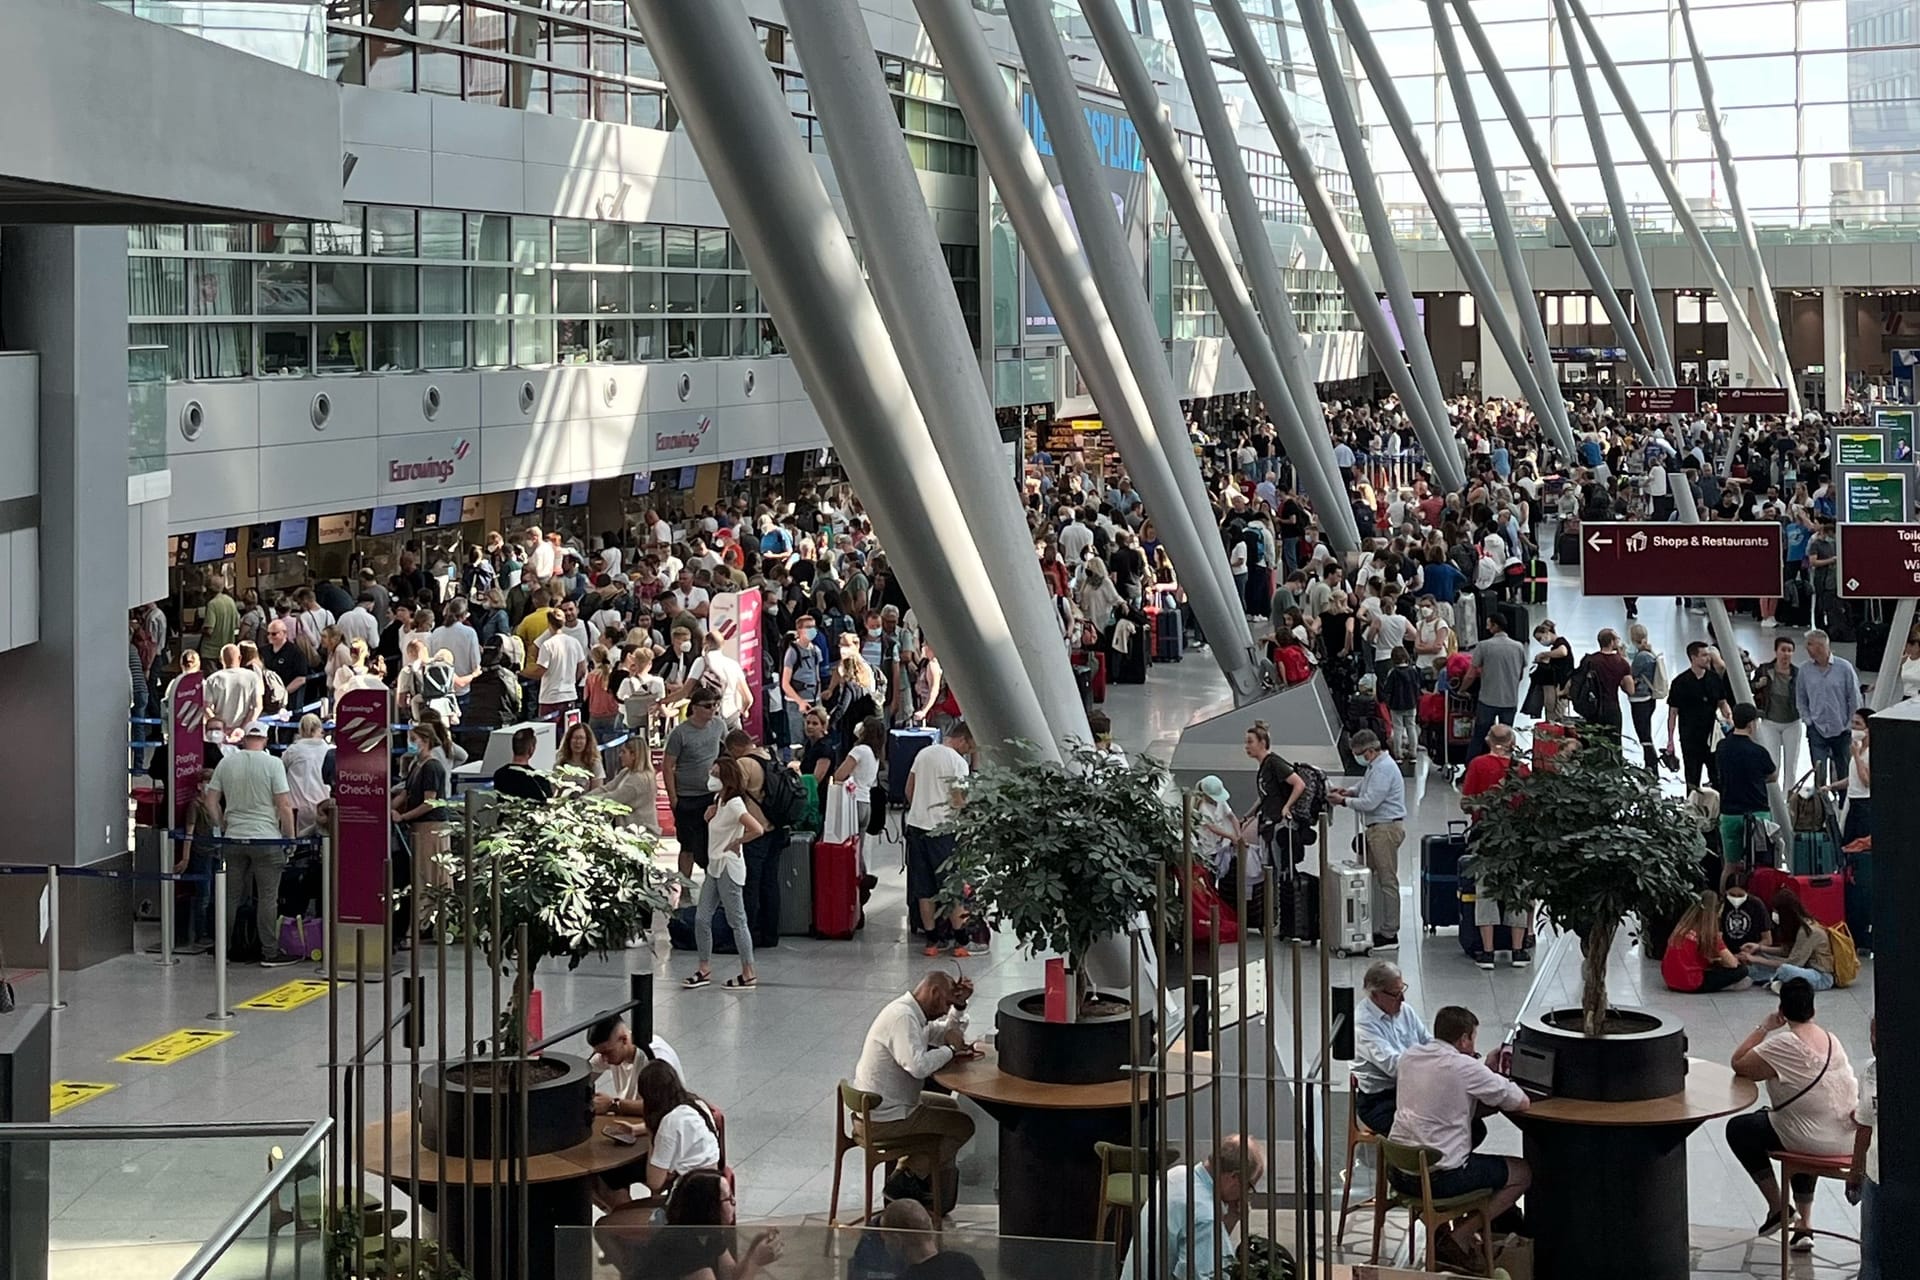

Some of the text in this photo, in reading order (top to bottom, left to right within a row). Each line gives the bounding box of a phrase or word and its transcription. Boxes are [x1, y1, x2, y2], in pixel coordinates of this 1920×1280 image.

[655, 429, 700, 453] Eurowings
[389, 456, 454, 483] Eurowings
[1653, 536, 1769, 548] Shops & Restaurants
[339, 770, 379, 784] Priority-
[339, 784, 384, 796] Check-in
